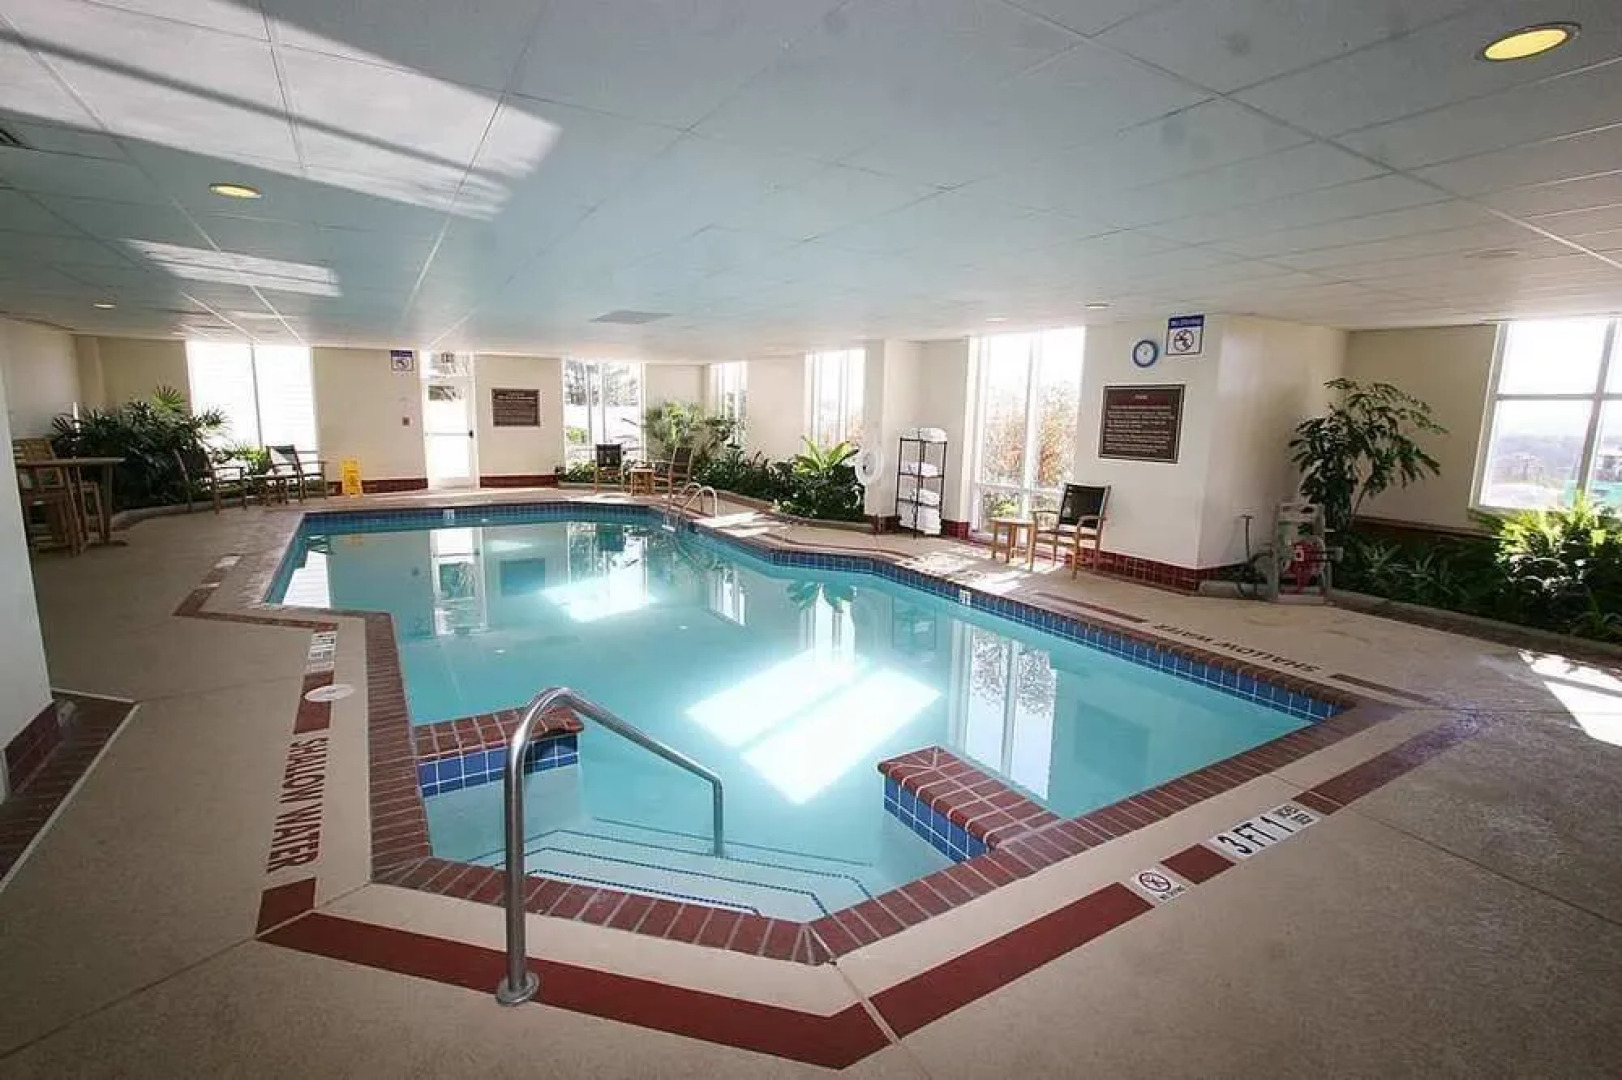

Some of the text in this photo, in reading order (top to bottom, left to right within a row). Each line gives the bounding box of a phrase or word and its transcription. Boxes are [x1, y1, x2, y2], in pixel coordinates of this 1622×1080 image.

[1212, 640, 1321, 673] SHALLOW
[266, 737, 329, 874] SHALLOW WATER
